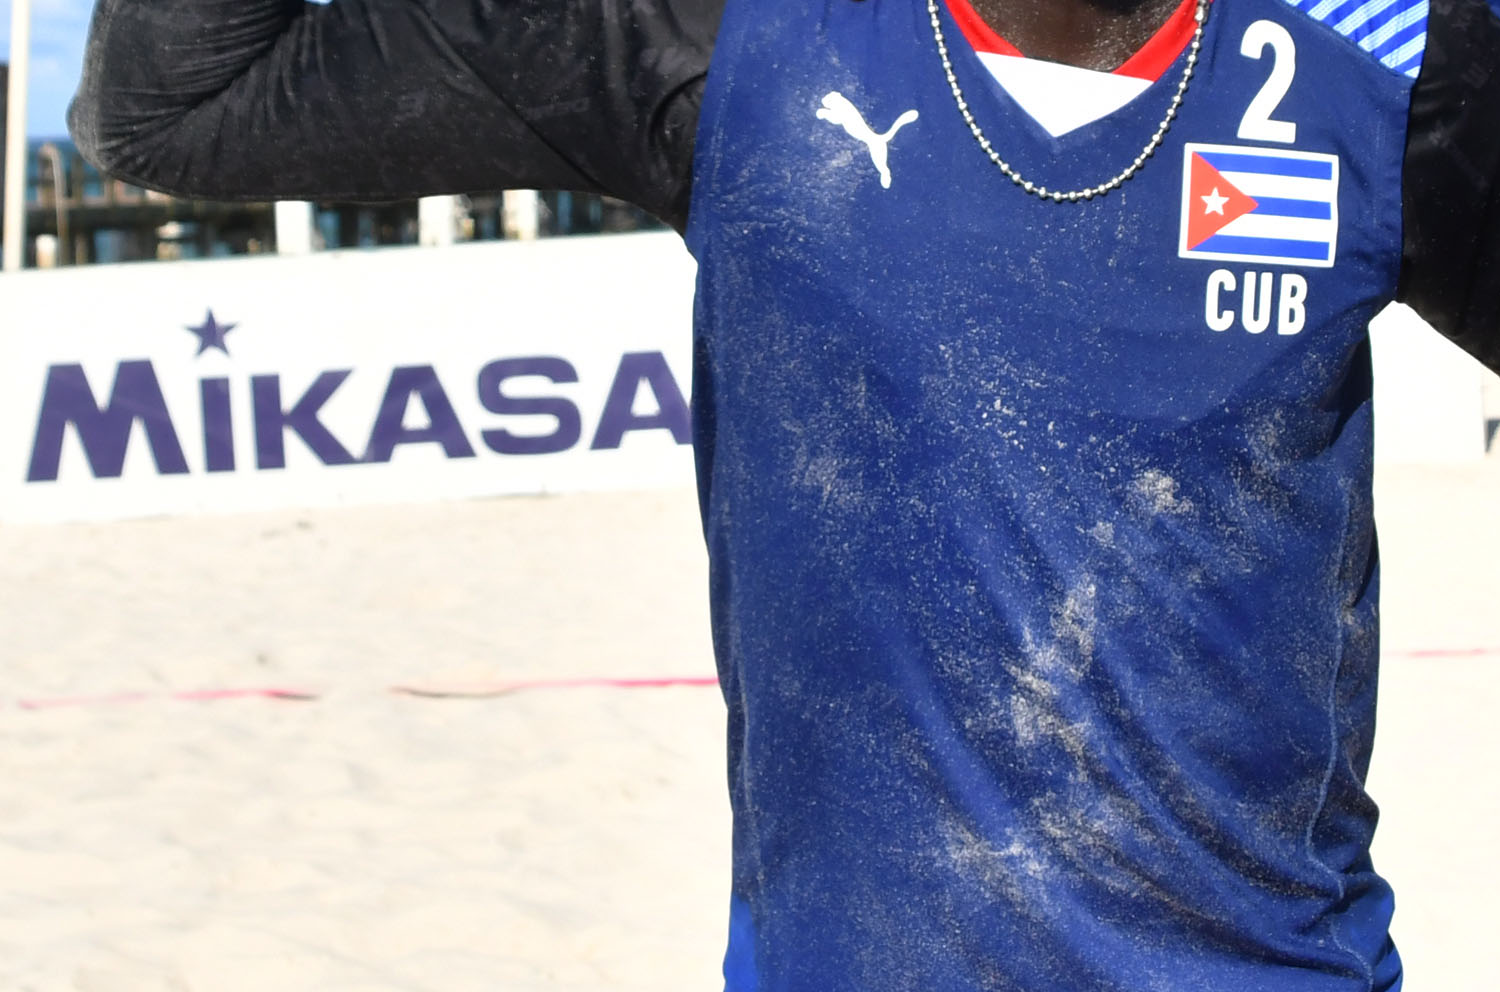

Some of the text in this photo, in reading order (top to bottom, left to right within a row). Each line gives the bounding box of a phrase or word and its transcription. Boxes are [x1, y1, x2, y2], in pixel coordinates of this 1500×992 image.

[1237, 19, 1297, 144] 2
[1204, 268, 1308, 336] CUB
[25, 349, 694, 482] MIKASA
